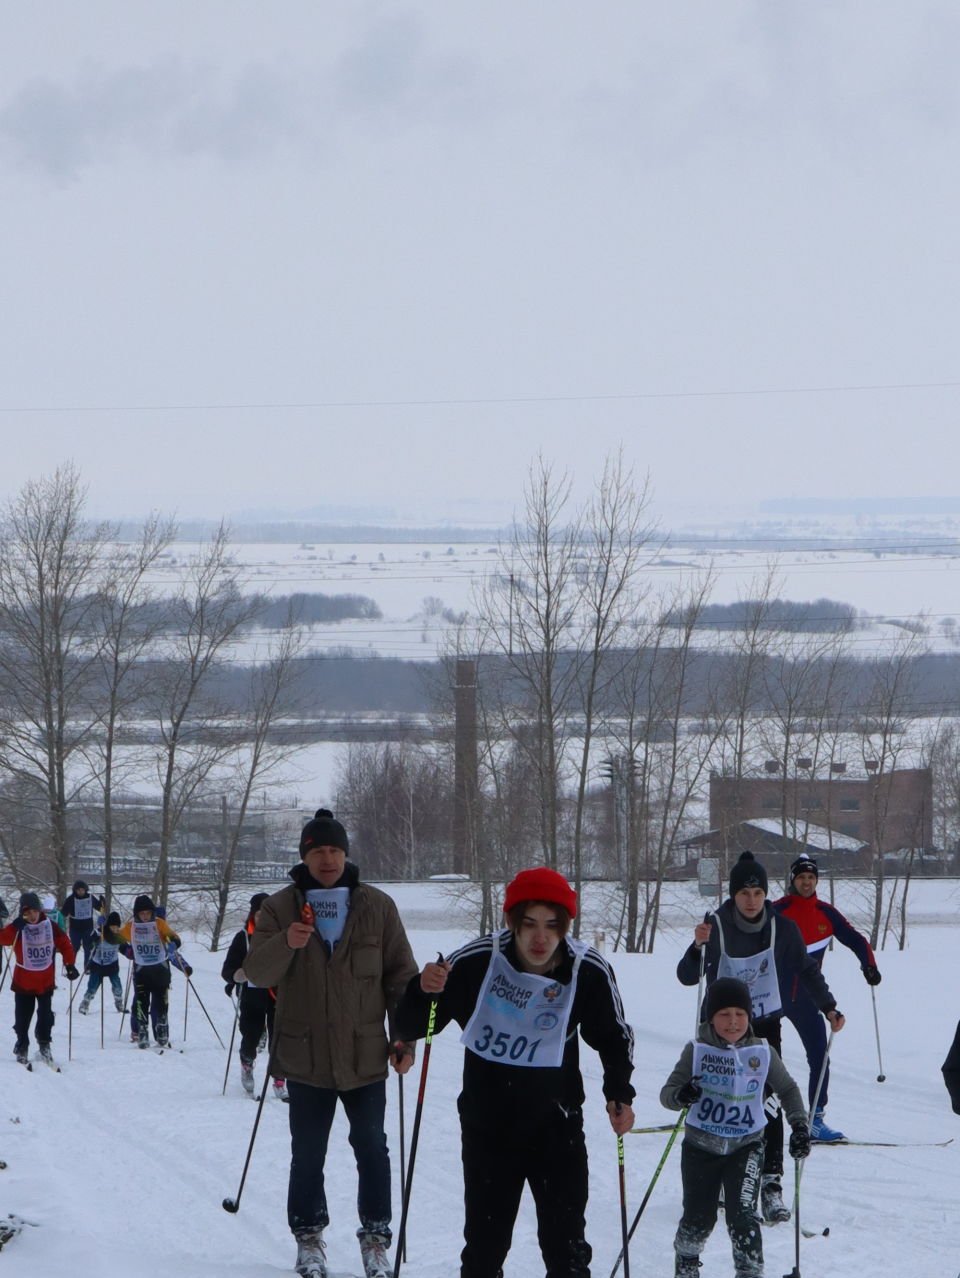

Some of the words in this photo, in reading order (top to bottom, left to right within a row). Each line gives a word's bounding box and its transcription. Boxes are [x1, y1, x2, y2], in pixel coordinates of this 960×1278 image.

[27, 945, 51, 959] 9036
[136, 944, 161, 955] 9076
[490, 984, 528, 1010] РОССИИ
[493, 974, 533, 1000] ЛЫЖНЯ
[474, 1025, 543, 1063] 3501
[701, 1054, 735, 1067] ЛЫЖНЯ
[701, 1063, 737, 1076] РОССИИ
[701, 1074, 735, 1088] 2021
[697, 1098, 755, 1128] 9024
[745, 1159, 759, 1179] KEEP
[740, 1177, 755, 1201] CALM
